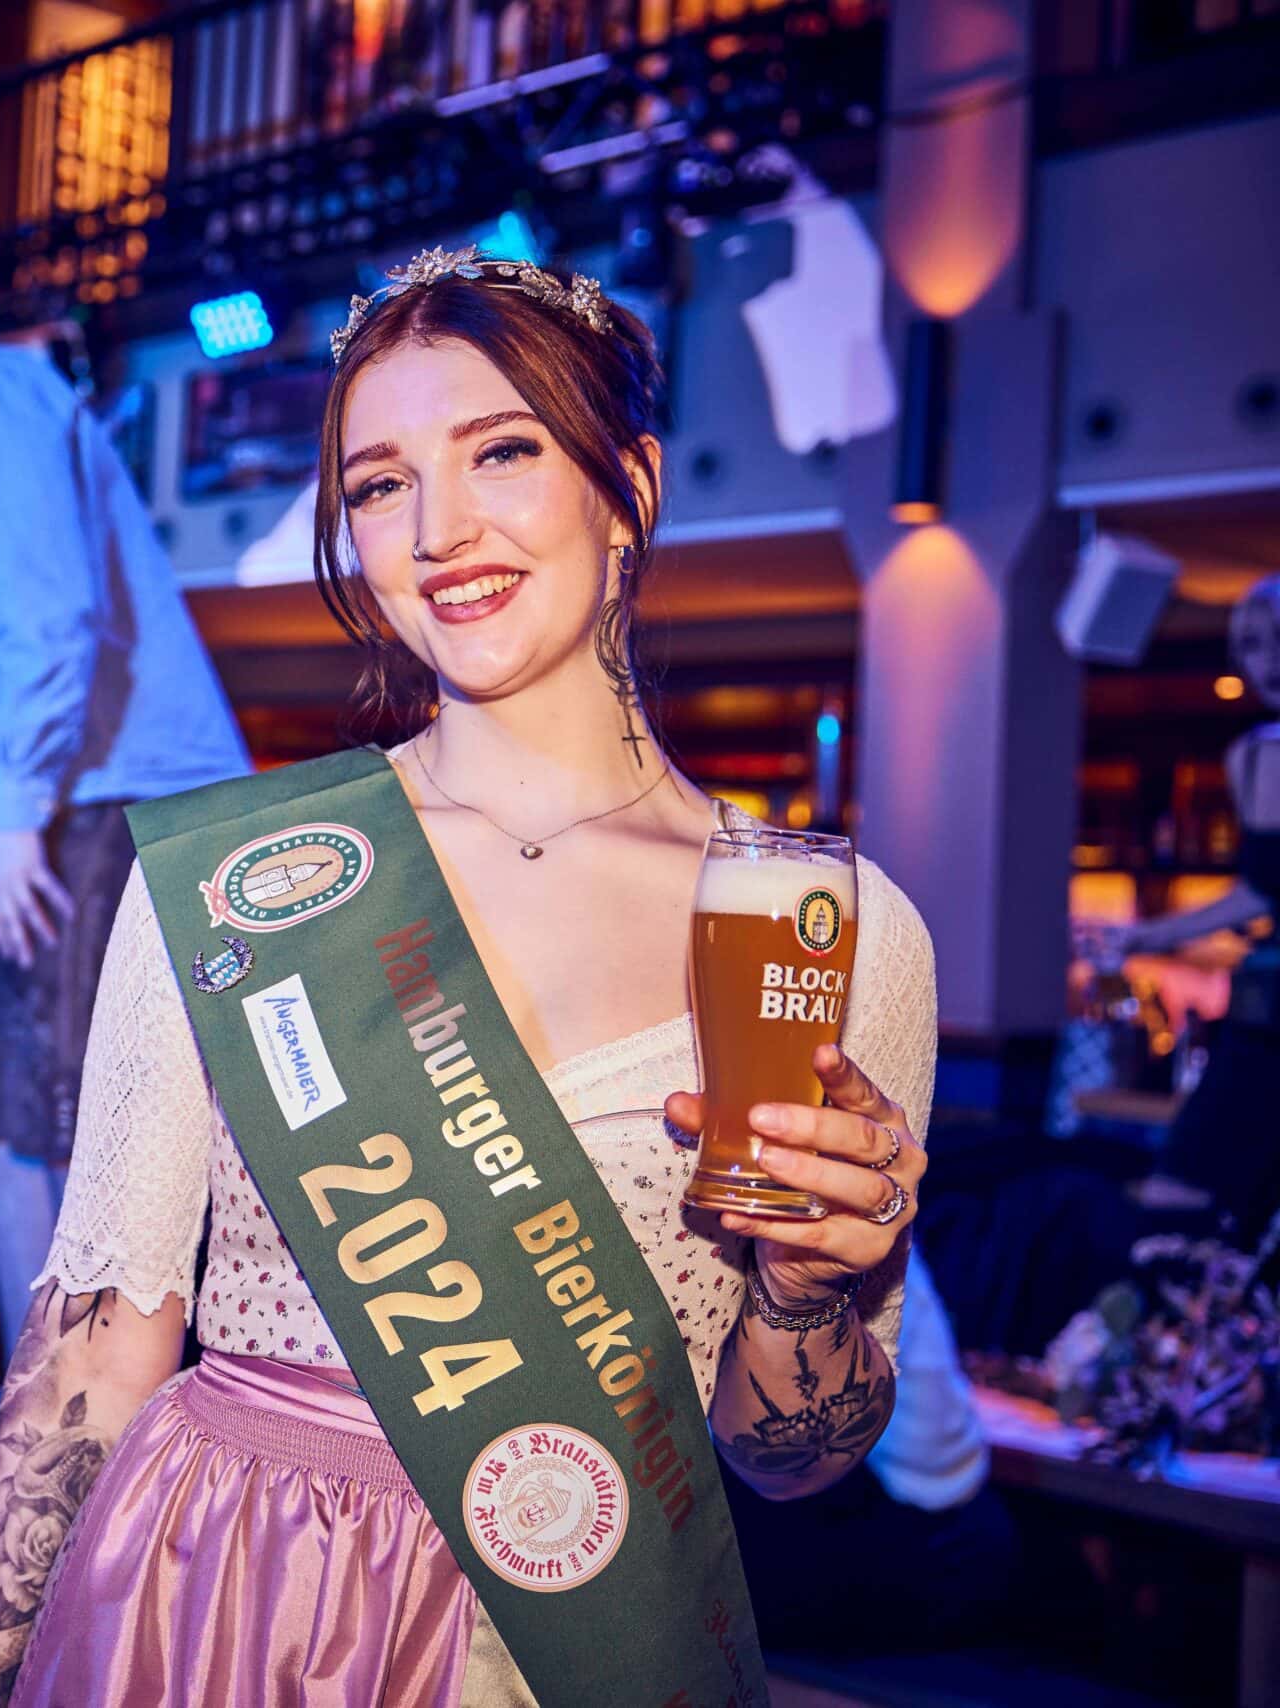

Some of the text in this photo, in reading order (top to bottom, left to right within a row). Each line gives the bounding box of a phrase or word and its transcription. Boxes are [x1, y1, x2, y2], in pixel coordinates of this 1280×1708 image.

[271, 835, 353, 854] BRAUHAUS
[345, 859, 357, 876] AM
[294, 882, 345, 912] HAFEN
[761, 962, 847, 993] BLOCK
[759, 989, 843, 1025] BRÄU
[263, 997, 321, 1112] ANGERMAIER
[373, 916, 542, 1197] Hamburger
[298, 1132, 524, 1417] 2024
[512, 1199, 697, 1533] Bierkönigin
[473, 1504, 564, 1579] Fischmarkt
